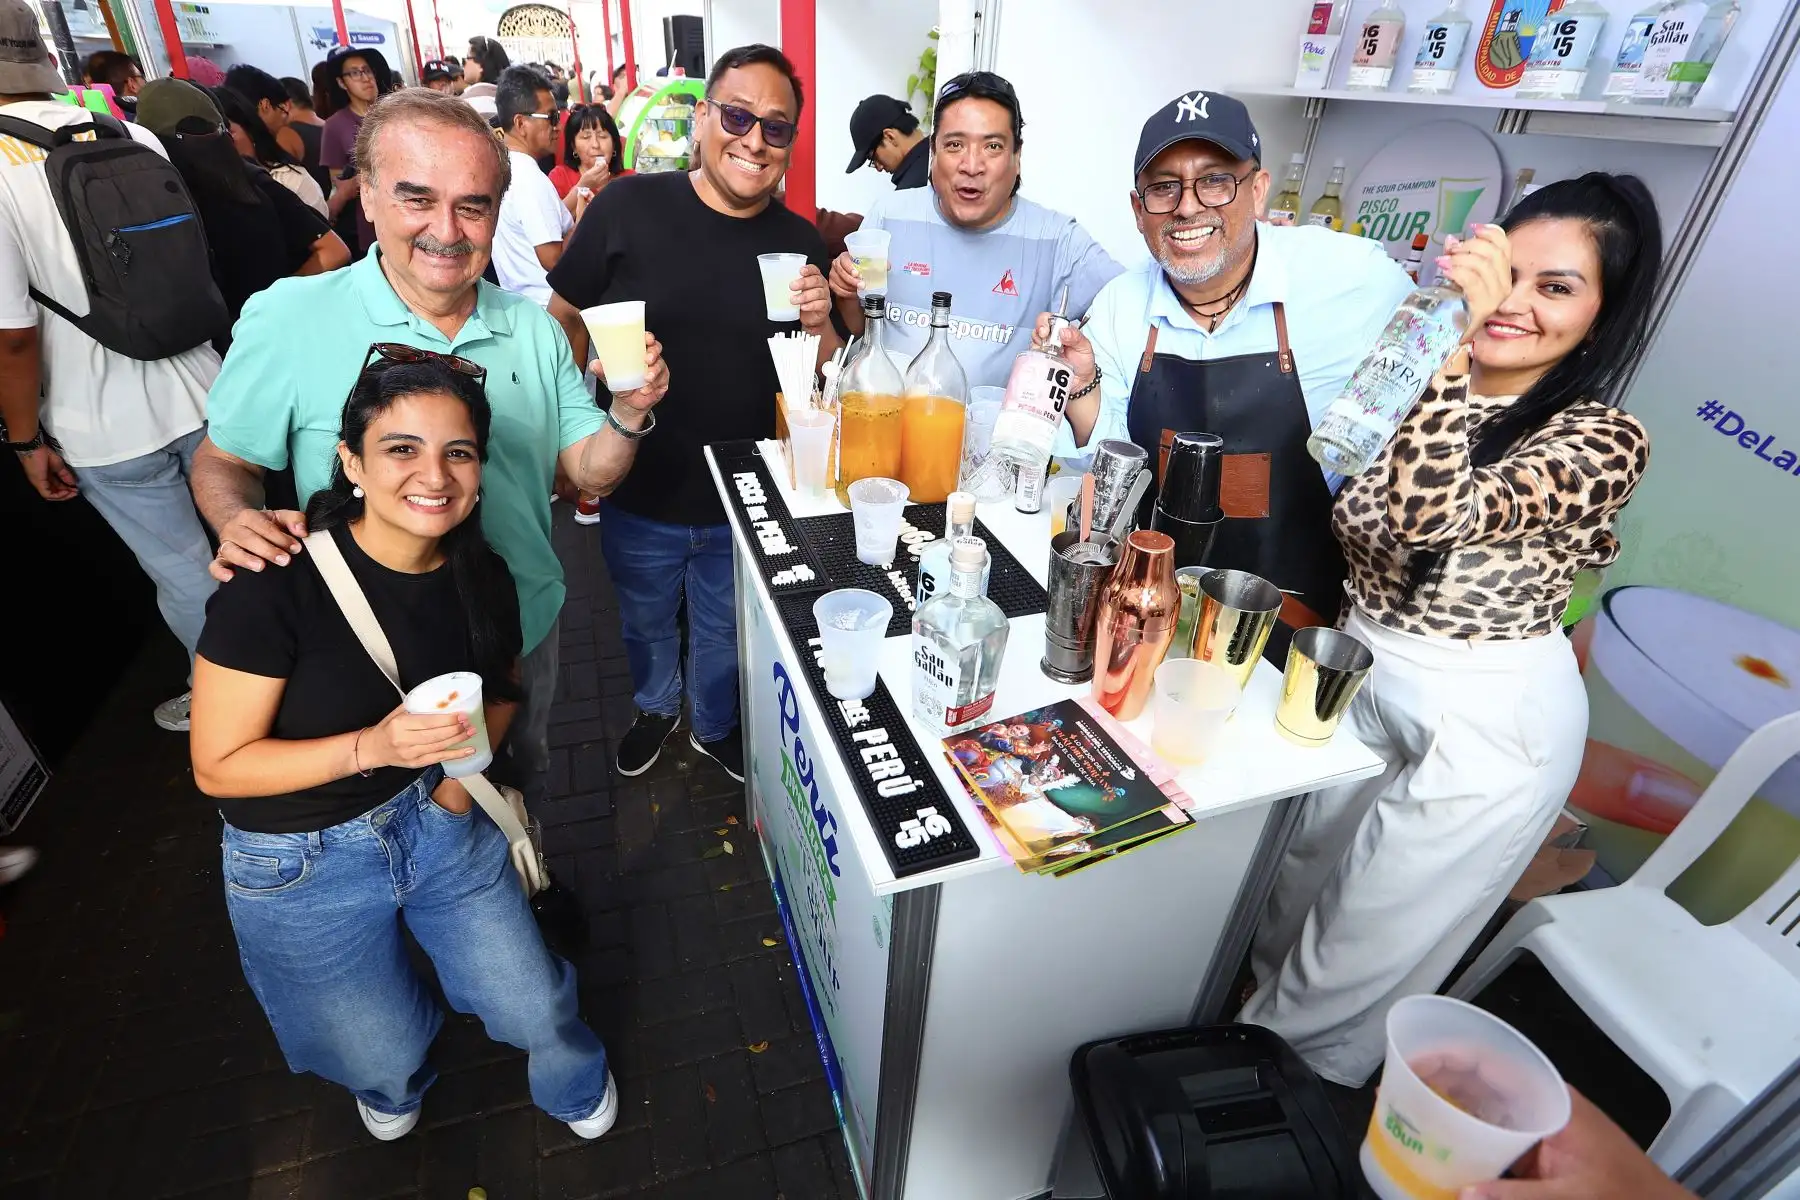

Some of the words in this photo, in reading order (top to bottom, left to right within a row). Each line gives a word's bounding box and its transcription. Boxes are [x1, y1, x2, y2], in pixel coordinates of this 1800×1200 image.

[1362, 25, 1380, 38] 16
[1428, 28, 1448, 40] 16
[1553, 20, 1578, 36] 16
[1661, 20, 1684, 34] San
[1303, 41, 1327, 55] Perú
[1362, 39, 1378, 56] 15
[1428, 42, 1446, 58] 15
[1479, 11, 1500, 81] MUNICIPALIDAD
[1504, 70, 1517, 82] DE
[1552, 37, 1575, 57] 15
[1175, 92, 1210, 123] NY
[1362, 186, 1374, 194] THE
[1376, 183, 1396, 194] SOUR
[1398, 180, 1437, 192] CHAMPION
[1358, 198, 1400, 214] PISCO
[1356, 211, 1431, 242] SOUR
[886, 302, 900, 322] le
[904, 310, 932, 328] co
[948, 319, 1014, 344] sportif
[1046, 368, 1070, 388] 16
[1049, 386, 1066, 412] 15
[886, 570, 916, 611] bitters
[921, 646, 944, 669] San
[852, 727, 924, 798] PERÚ
[1050, 735, 1063, 749] BAJO
[1066, 753, 1080, 768] CIELO
[1077, 766, 1086, 775] DE
[1084, 773, 1096, 787] LIMA
[1073, 738, 1081, 746] LO
[1079, 744, 1095, 762] MEJOR
[1093, 761, 1103, 772] DEL
[773, 662, 840, 877] Perú
[784, 762, 832, 899] produce
[916, 806, 950, 835] 16
[894, 818, 930, 850] 15
